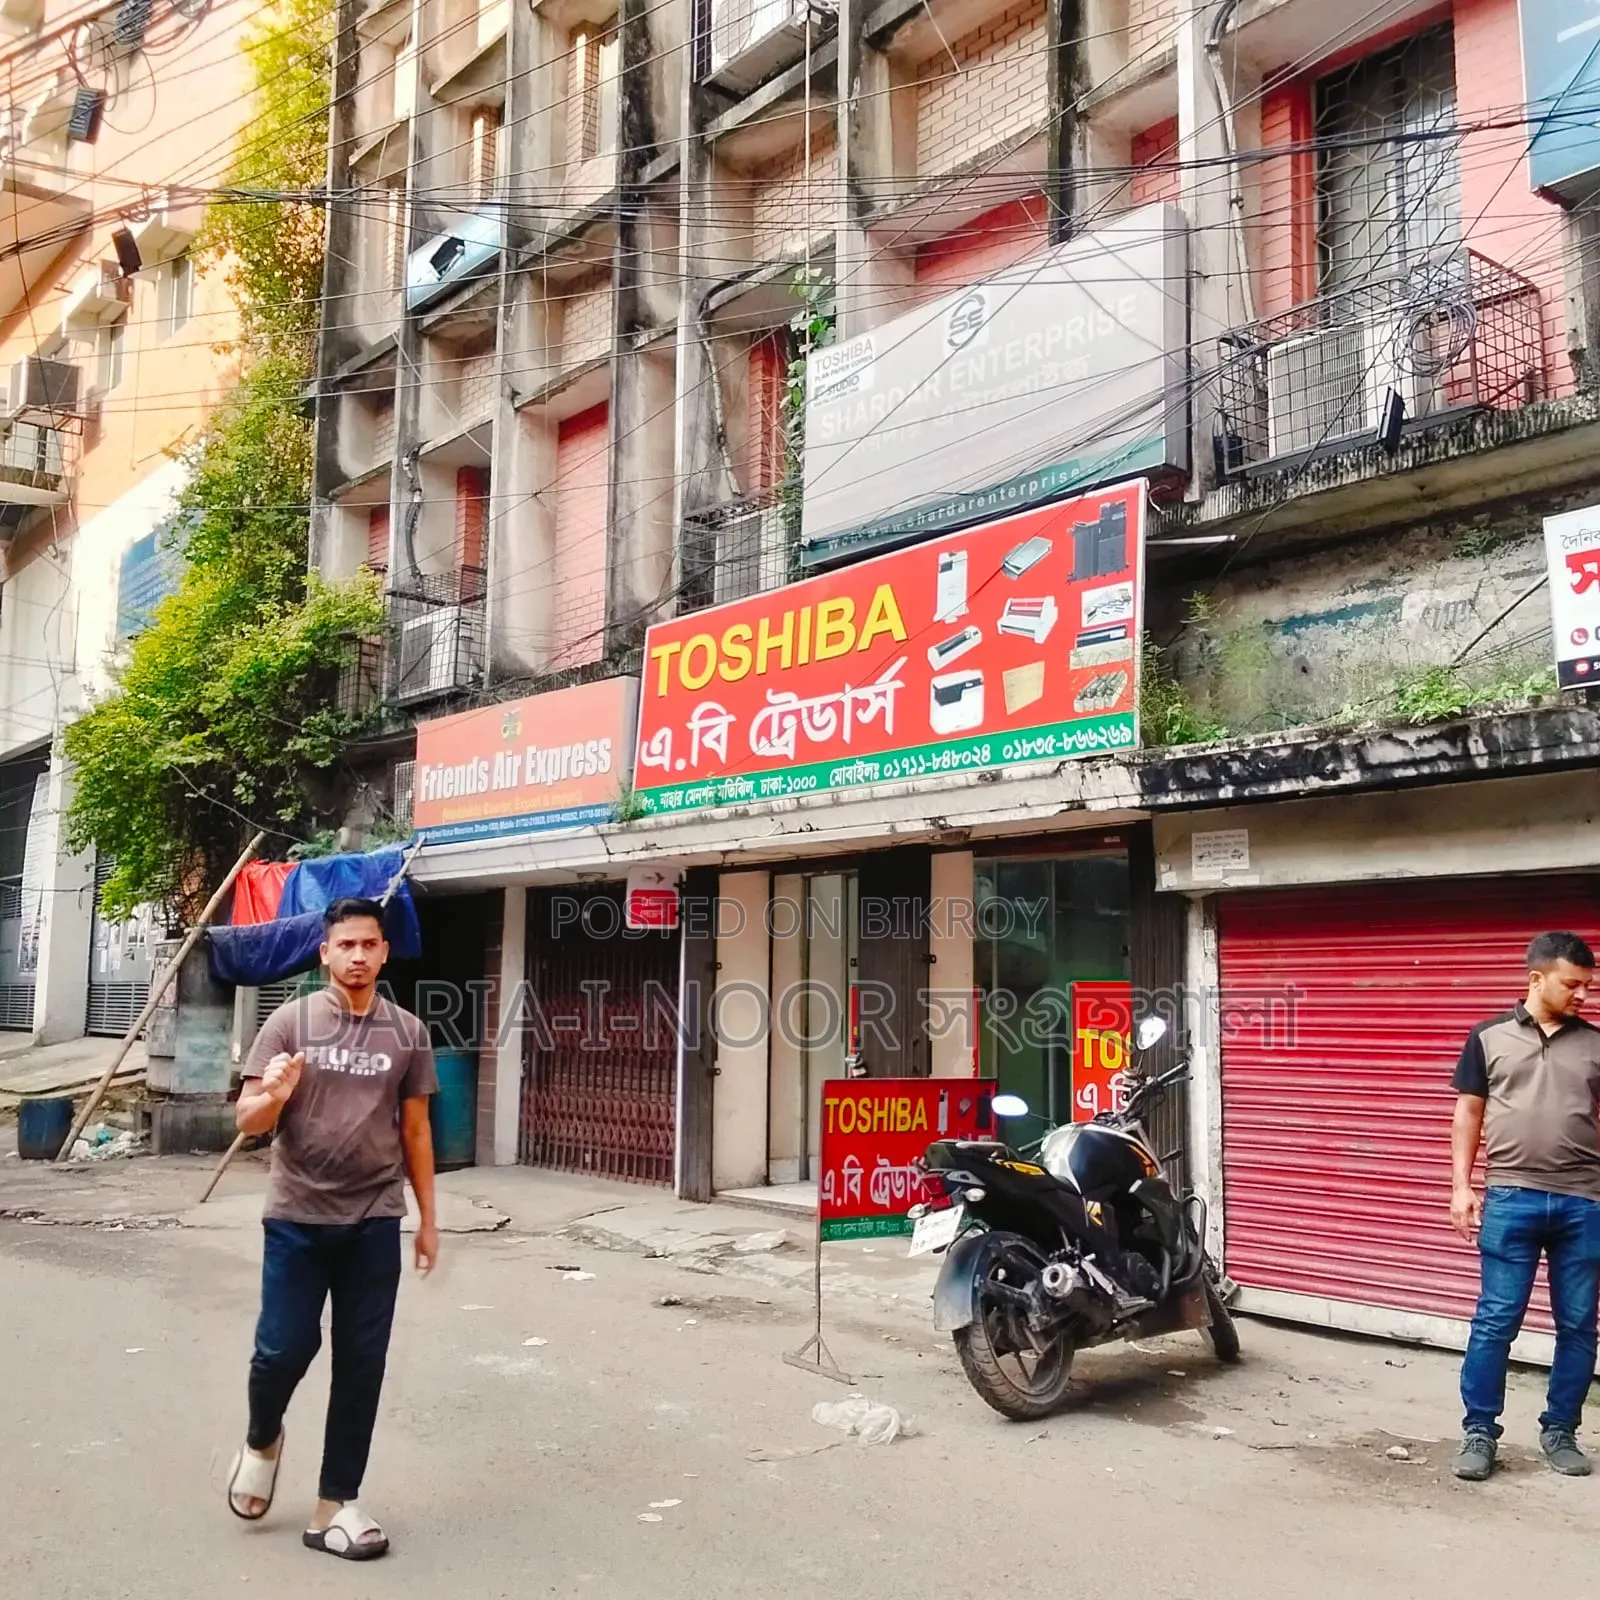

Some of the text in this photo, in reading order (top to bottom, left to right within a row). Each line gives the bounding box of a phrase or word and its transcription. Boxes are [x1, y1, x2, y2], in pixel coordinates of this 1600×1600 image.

[814, 337, 873, 374] TOSHIBA
[949, 293, 1139, 394] ENTERPRISE
[651, 583, 908, 697] TOSHIBA
[640, 655, 908, 772] এ.বি ট্রেডার্স
[419, 737, 612, 802] Friends Air Express
[759, 773, 817, 796] ঢাকা-১০০০
[829, 756, 881, 787] মোবাইলঃ
[883, 743, 992, 777] ০১৭১১-৮৪৮০২৪
[1002, 722, 1133, 760] ০১৮৩৫-৮৬৬২৬৯
[305, 1046, 392, 1072] HUGO
[824, 1097, 928, 1134] TOSHIBA
[821, 1155, 864, 1207] এ.বি
